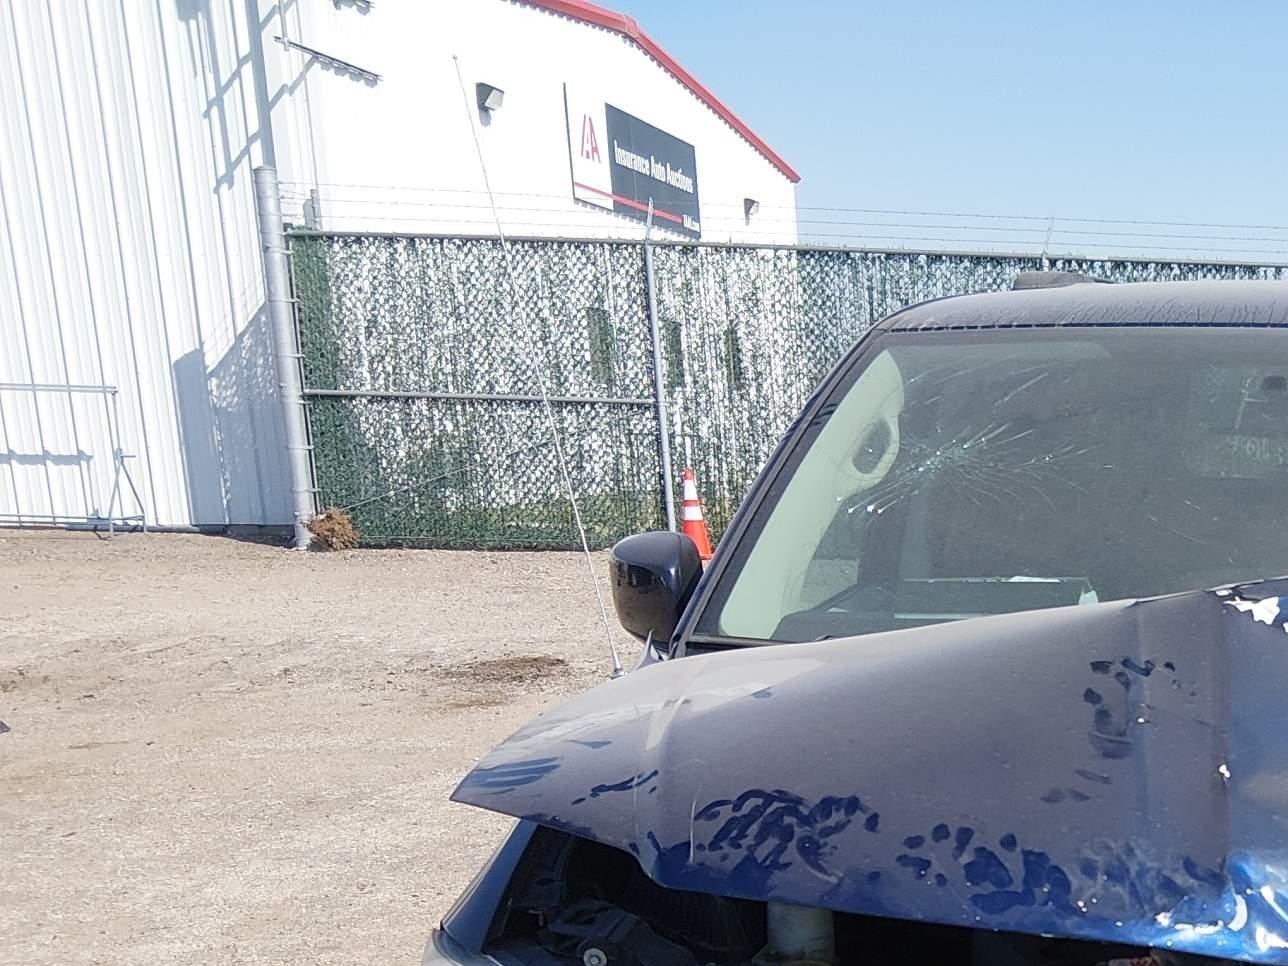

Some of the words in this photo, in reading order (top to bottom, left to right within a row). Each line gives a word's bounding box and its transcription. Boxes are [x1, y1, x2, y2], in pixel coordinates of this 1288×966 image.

[613, 139, 650, 176] Insurance
[650, 155, 666, 183] Auto
[666, 162, 694, 194] Auctions
